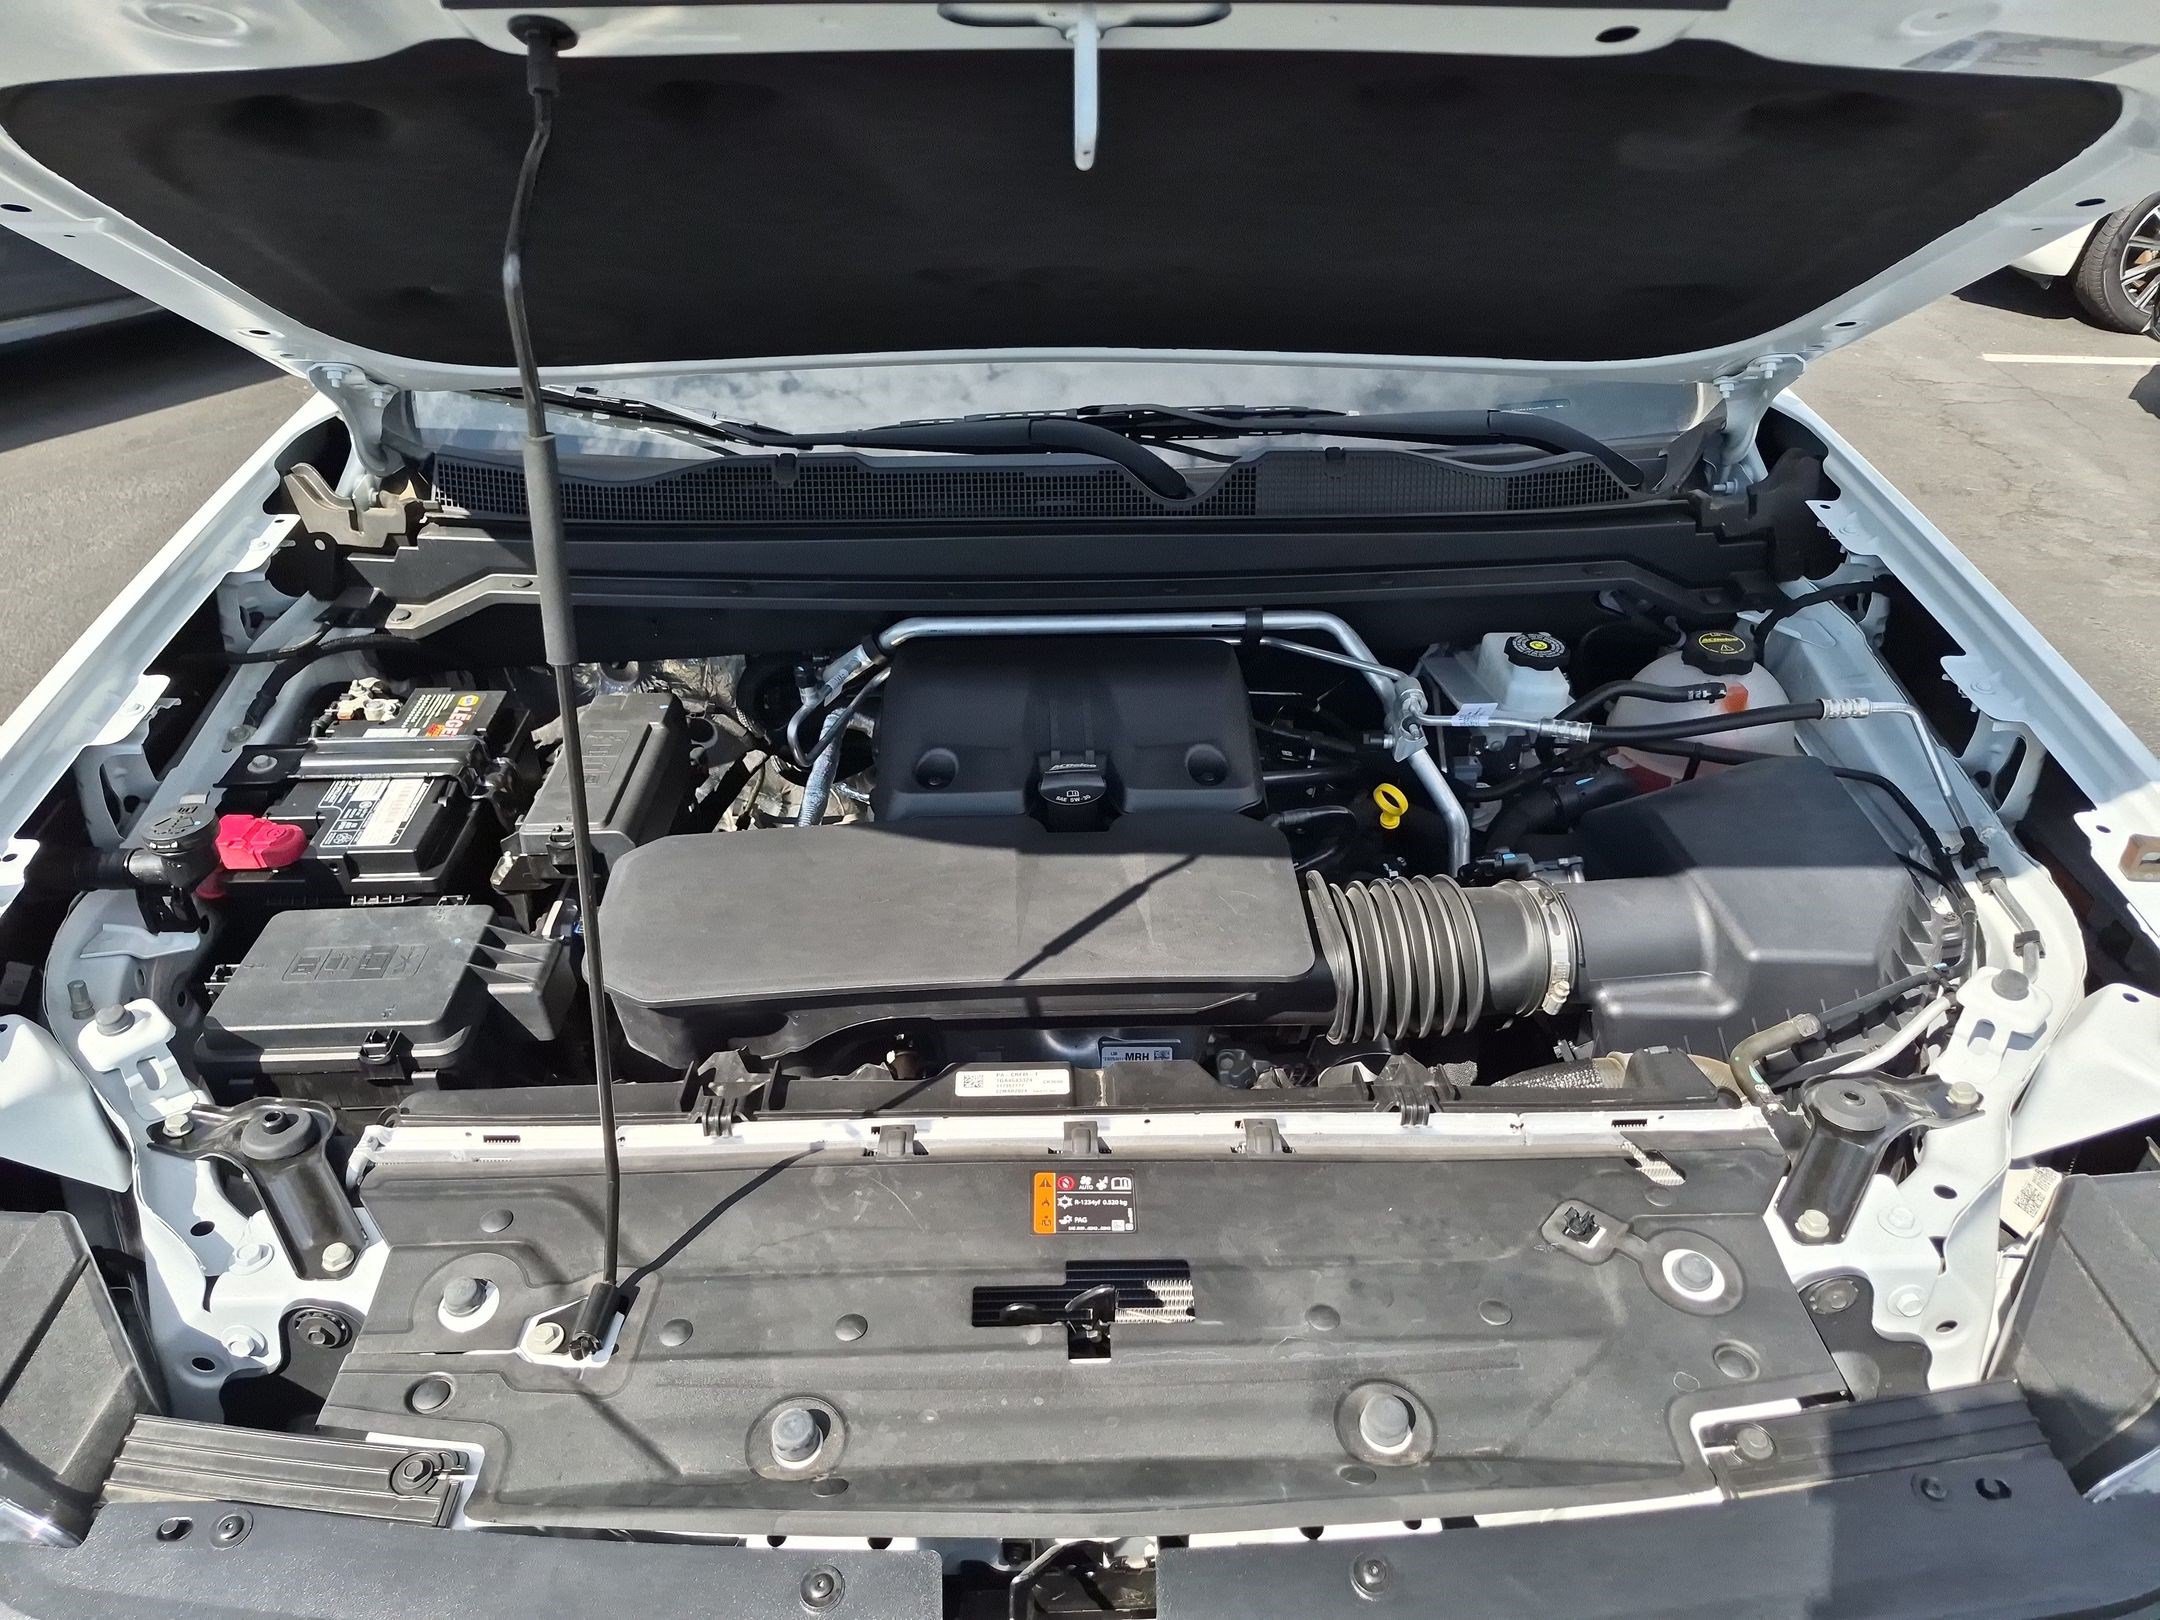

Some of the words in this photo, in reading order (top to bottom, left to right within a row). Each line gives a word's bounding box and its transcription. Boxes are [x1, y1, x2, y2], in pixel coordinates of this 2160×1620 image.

[439, 706, 472, 736] LEGE
[1125, 1052, 1150, 1061] MRH
[1074, 1199, 1101, 1207] R-1234yf
[1119, 1199, 1128, 1207] kg
